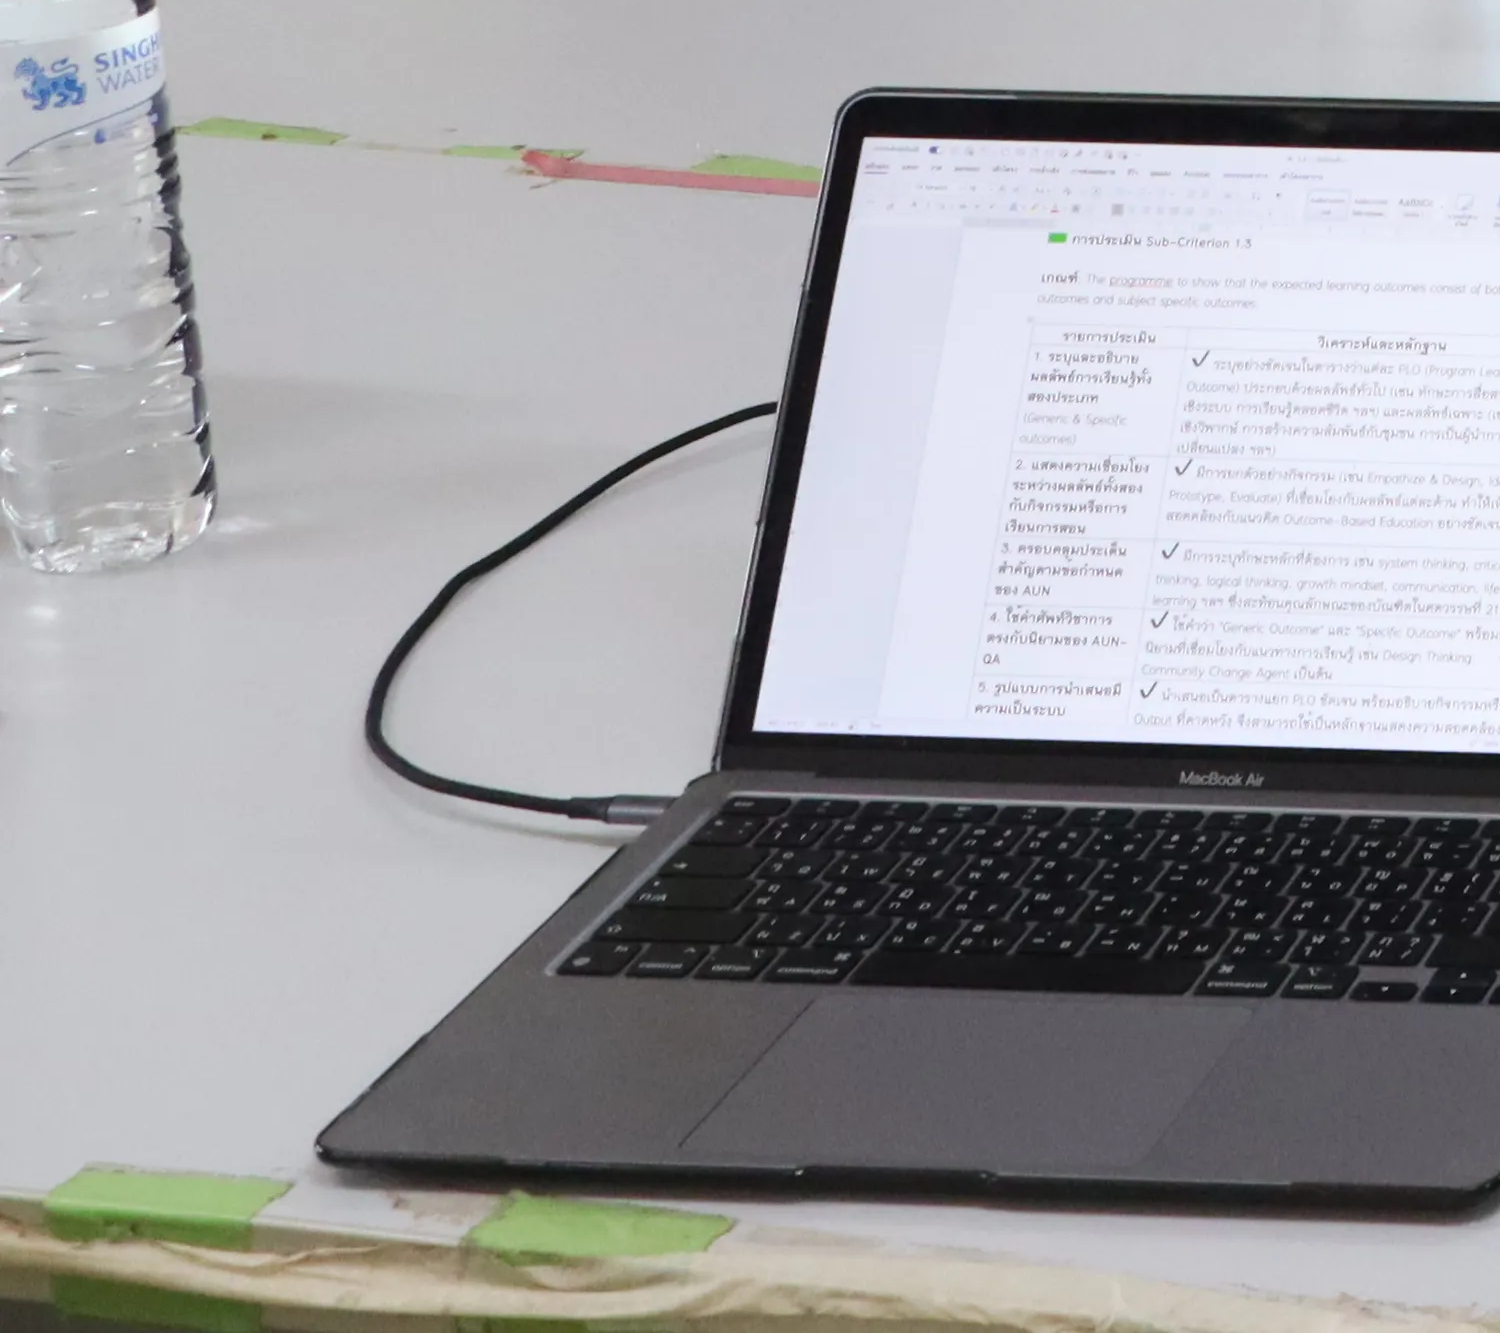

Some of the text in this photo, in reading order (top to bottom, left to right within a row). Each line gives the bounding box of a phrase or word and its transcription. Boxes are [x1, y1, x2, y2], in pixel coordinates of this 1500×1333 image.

[1087, 273, 1107, 285] The
[1108, 275, 1174, 289] programme
[1177, 277, 1188, 288] to
[1191, 276, 1221, 288] show
[1224, 277, 1247, 289] that
[1250, 277, 1268, 289] the
[1271, 279, 1324, 291] expected
[1326, 279, 1371, 294] learning
[1372, 282, 1426, 293] outcomes
[1470, 283, 1483, 296] of
[1036, 293, 1198, 309] outcomes and subject specific
[1398, 363, 1422, 376] PLO
[1367, 472, 1426, 486] Empathize
[1379, 515, 1434, 529] Education
[1378, 558, 1418, 571] system
[1022, 584, 1051, 597] AUN
[1206, 574, 1243, 593] logical
[1296, 577, 1337, 592] growth
[1152, 594, 1198, 612] learning
[981, 652, 1001, 666] QA
[1382, 649, 1422, 664] Design
[1141, 663, 1206, 682] Community
[1208, 665, 1253, 683] Change
[1255, 666, 1290, 684] Agent
[1292, 693, 1316, 706] PLO
[1133, 712, 1172, 726] Output
[1178, 771, 1266, 788] MacBook Air
